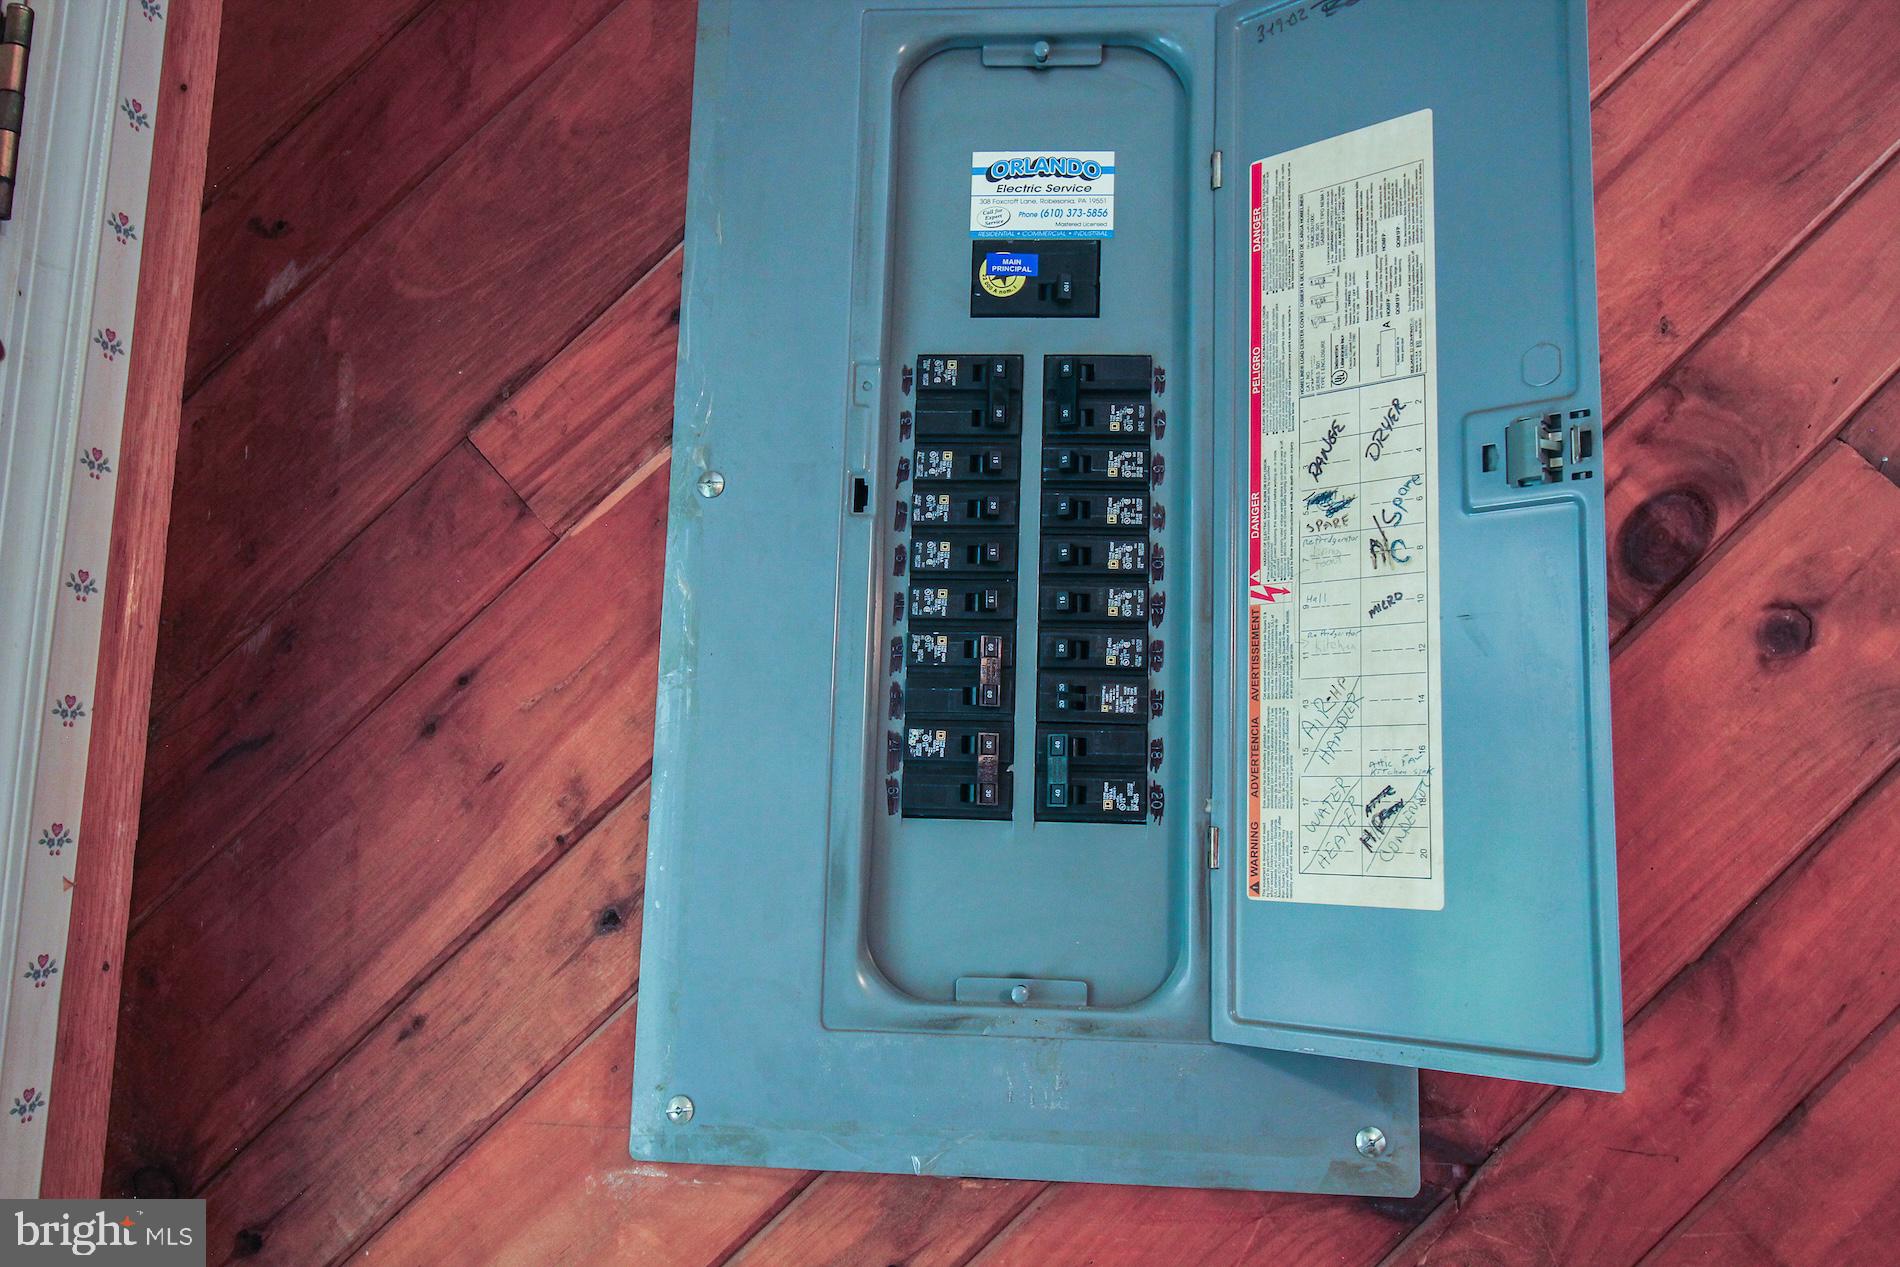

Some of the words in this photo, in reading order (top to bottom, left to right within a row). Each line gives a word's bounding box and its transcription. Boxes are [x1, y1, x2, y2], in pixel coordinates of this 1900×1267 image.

[987, 157, 1102, 181] ORLANDO
[997, 184, 1041, 193] Electric
[1045, 184, 1092, 193] Service
[1040, 208, 1064, 218] (610)
[1066, 208, 1108, 218] 373-5856
[1252, 207, 1262, 253] DANGER
[992, 265, 1032, 273] PRINCIPAL
[1252, 347, 1261, 394] PELIGRO
[1155, 418, 1165, 426] 4
[1365, 398, 1406, 462] DRYER
[1308, 419, 1346, 483] RANGE
[1062, 455, 1068, 463] 15
[991, 501, 997, 509] 20
[1061, 502, 1066, 510] 15
[1251, 492, 1259, 539] DANGER
[1306, 514, 1350, 533] SPARE
[990, 548, 996, 556] 15
[1062, 548, 1067, 556] 15
[1152, 555, 1163, 569] 10
[989, 595, 994, 603] 15
[1417, 594, 1424, 603] 10
[1368, 592, 1403, 619] MICRO
[1059, 644, 1065, 652] 20
[1418, 644, 1425, 652] 12
[1251, 609, 1259, 701] AVERTISSEMENT
[1059, 683, 1065, 691] 20
[1418, 694, 1424, 703] 14
[1059, 700, 1065, 708] 20
[1302, 700, 1309, 708] 13
[1319, 693, 1365, 765] HANDLER
[986, 741, 992, 749] 30
[1419, 745, 1426, 754] 16
[1302, 748, 1309, 756] 15
[1251, 717, 1259, 797] ADVERTENCIA
[985, 789, 992, 798] 30
[1055, 789, 1061, 798] 40
[1151, 791, 1163, 809] 20
[1303, 798, 1309, 806] 17
[1420, 798, 1427, 806] 18
[1305, 777, 1350, 833] WATER
[1318, 795, 1363, 869] HEATER
[1250, 821, 1258, 877] WARNING
[1302, 845, 1309, 854] 19
[1420, 849, 1428, 859] 20
